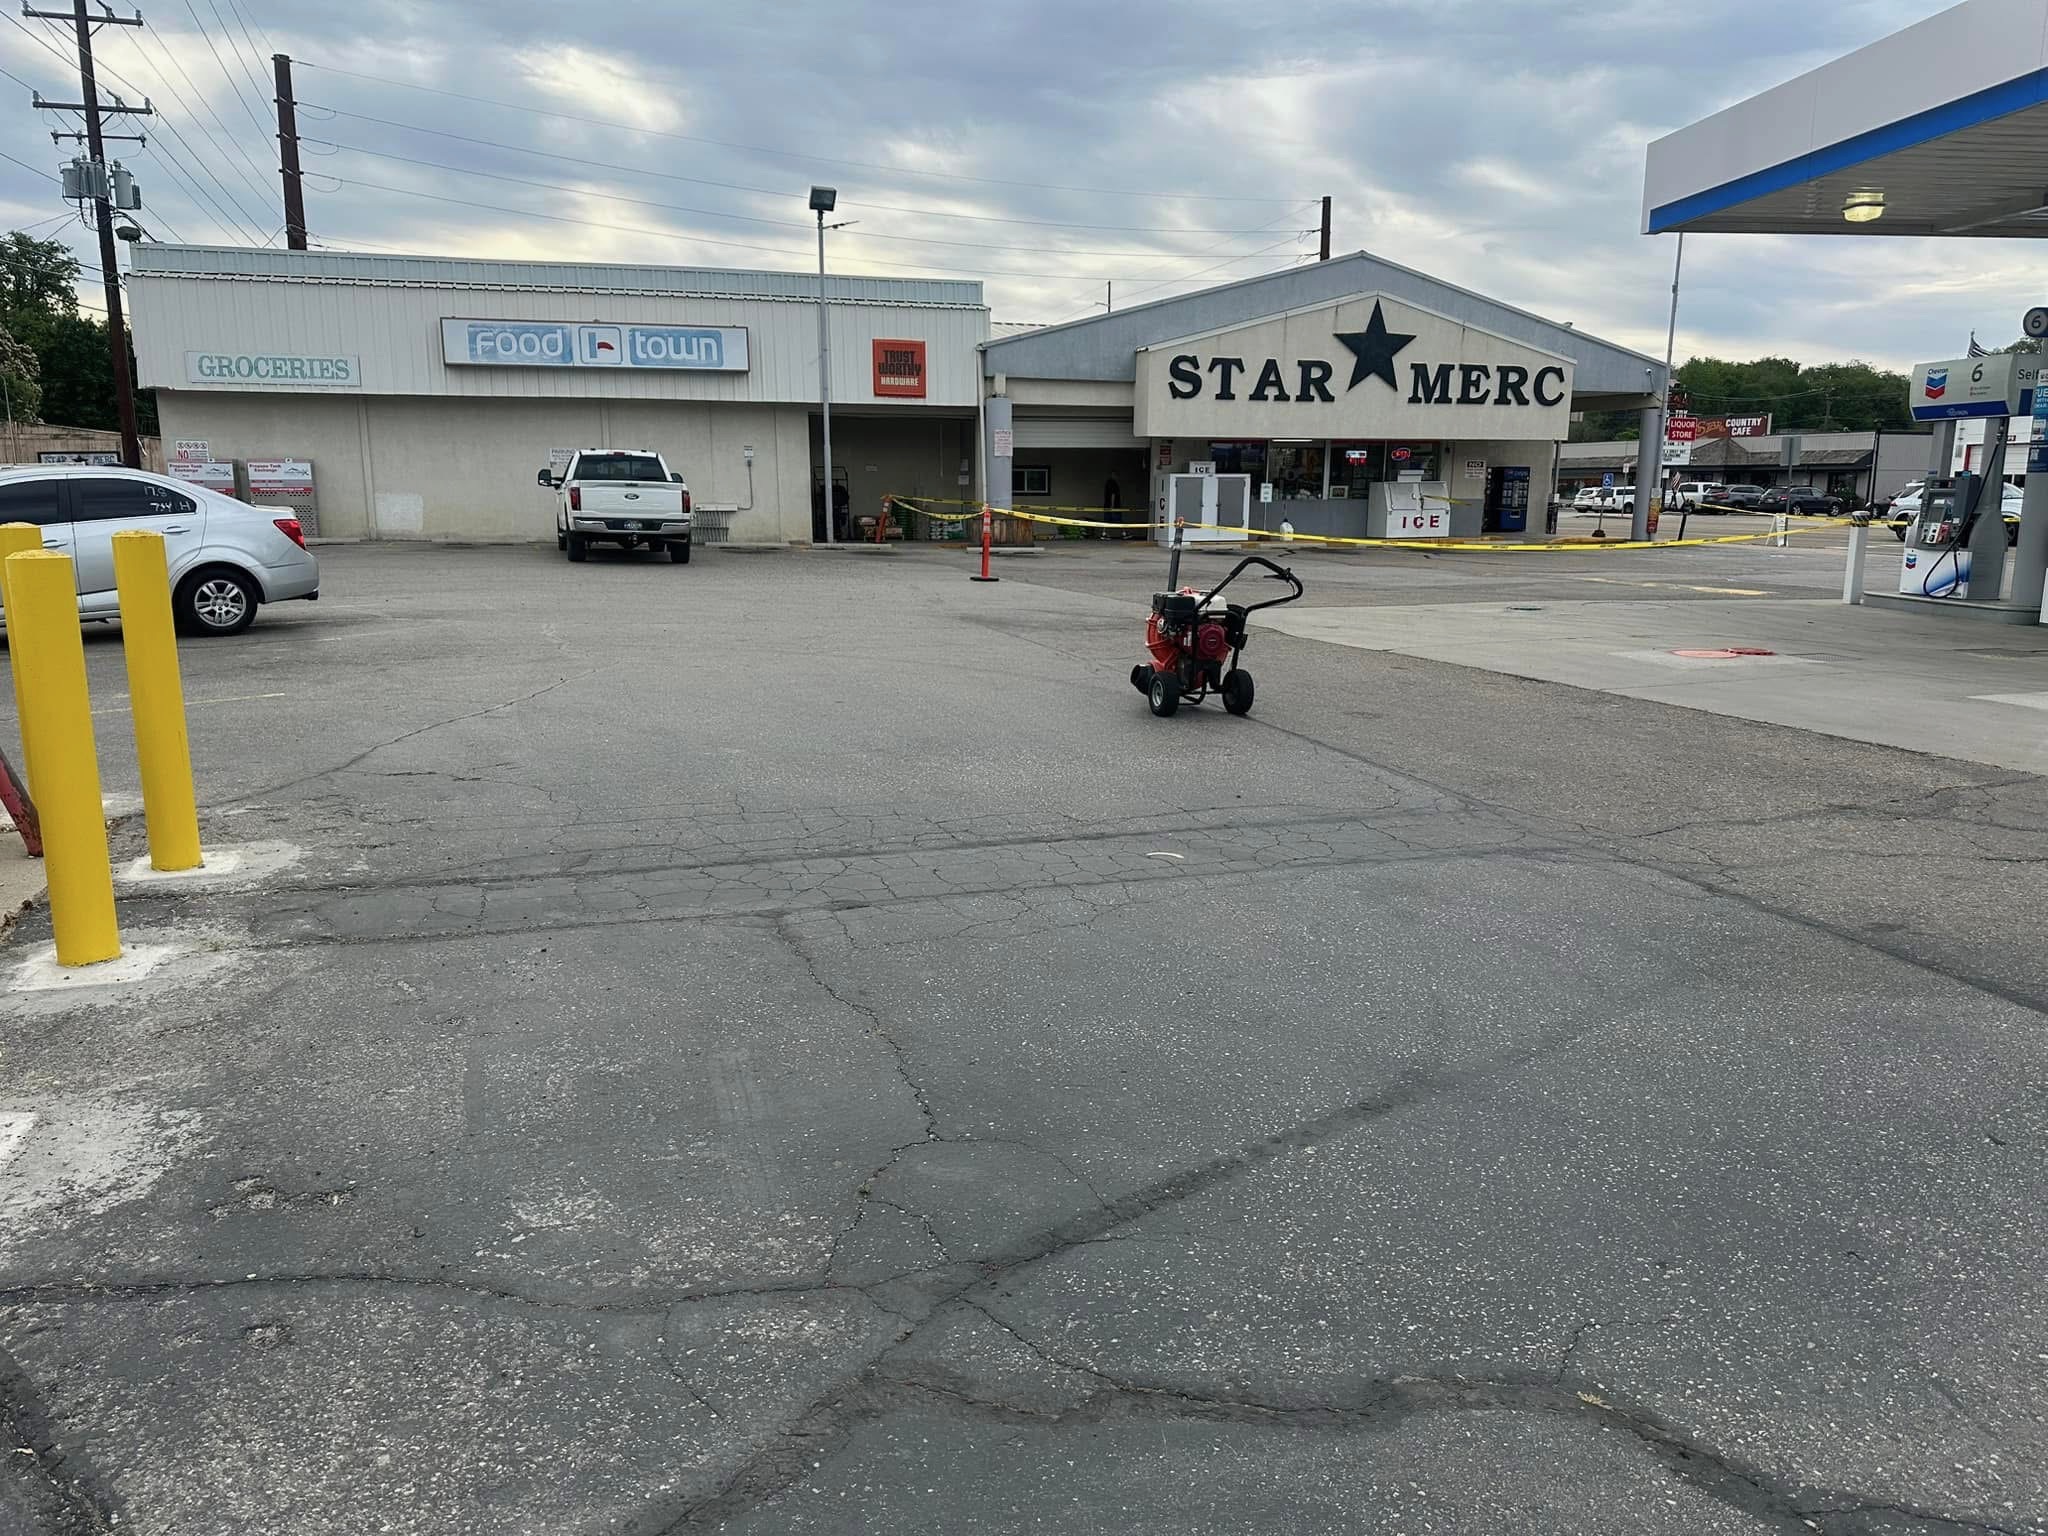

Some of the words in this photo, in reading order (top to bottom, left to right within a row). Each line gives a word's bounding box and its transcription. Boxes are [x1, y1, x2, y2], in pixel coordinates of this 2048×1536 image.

[2031, 315, 2042, 329] 6
[634, 330, 719, 361] town
[883, 350, 915, 363] TRUST
[198, 354, 350, 380] GROCERIES
[878, 362, 922, 376] WORTHY
[1971, 362, 1984, 382] 6
[2017, 368, 2040, 380] Self
[880, 377, 919, 386] HARDWARE
[1167, 354, 1336, 402] STAR
[1407, 362, 1566, 406] MERC
[1726, 418, 1762, 427] COUNTRY
[1731, 427, 1752, 436] CAFE
[177, 450, 190, 460] NO
[1402, 515, 1440, 529] ICE
